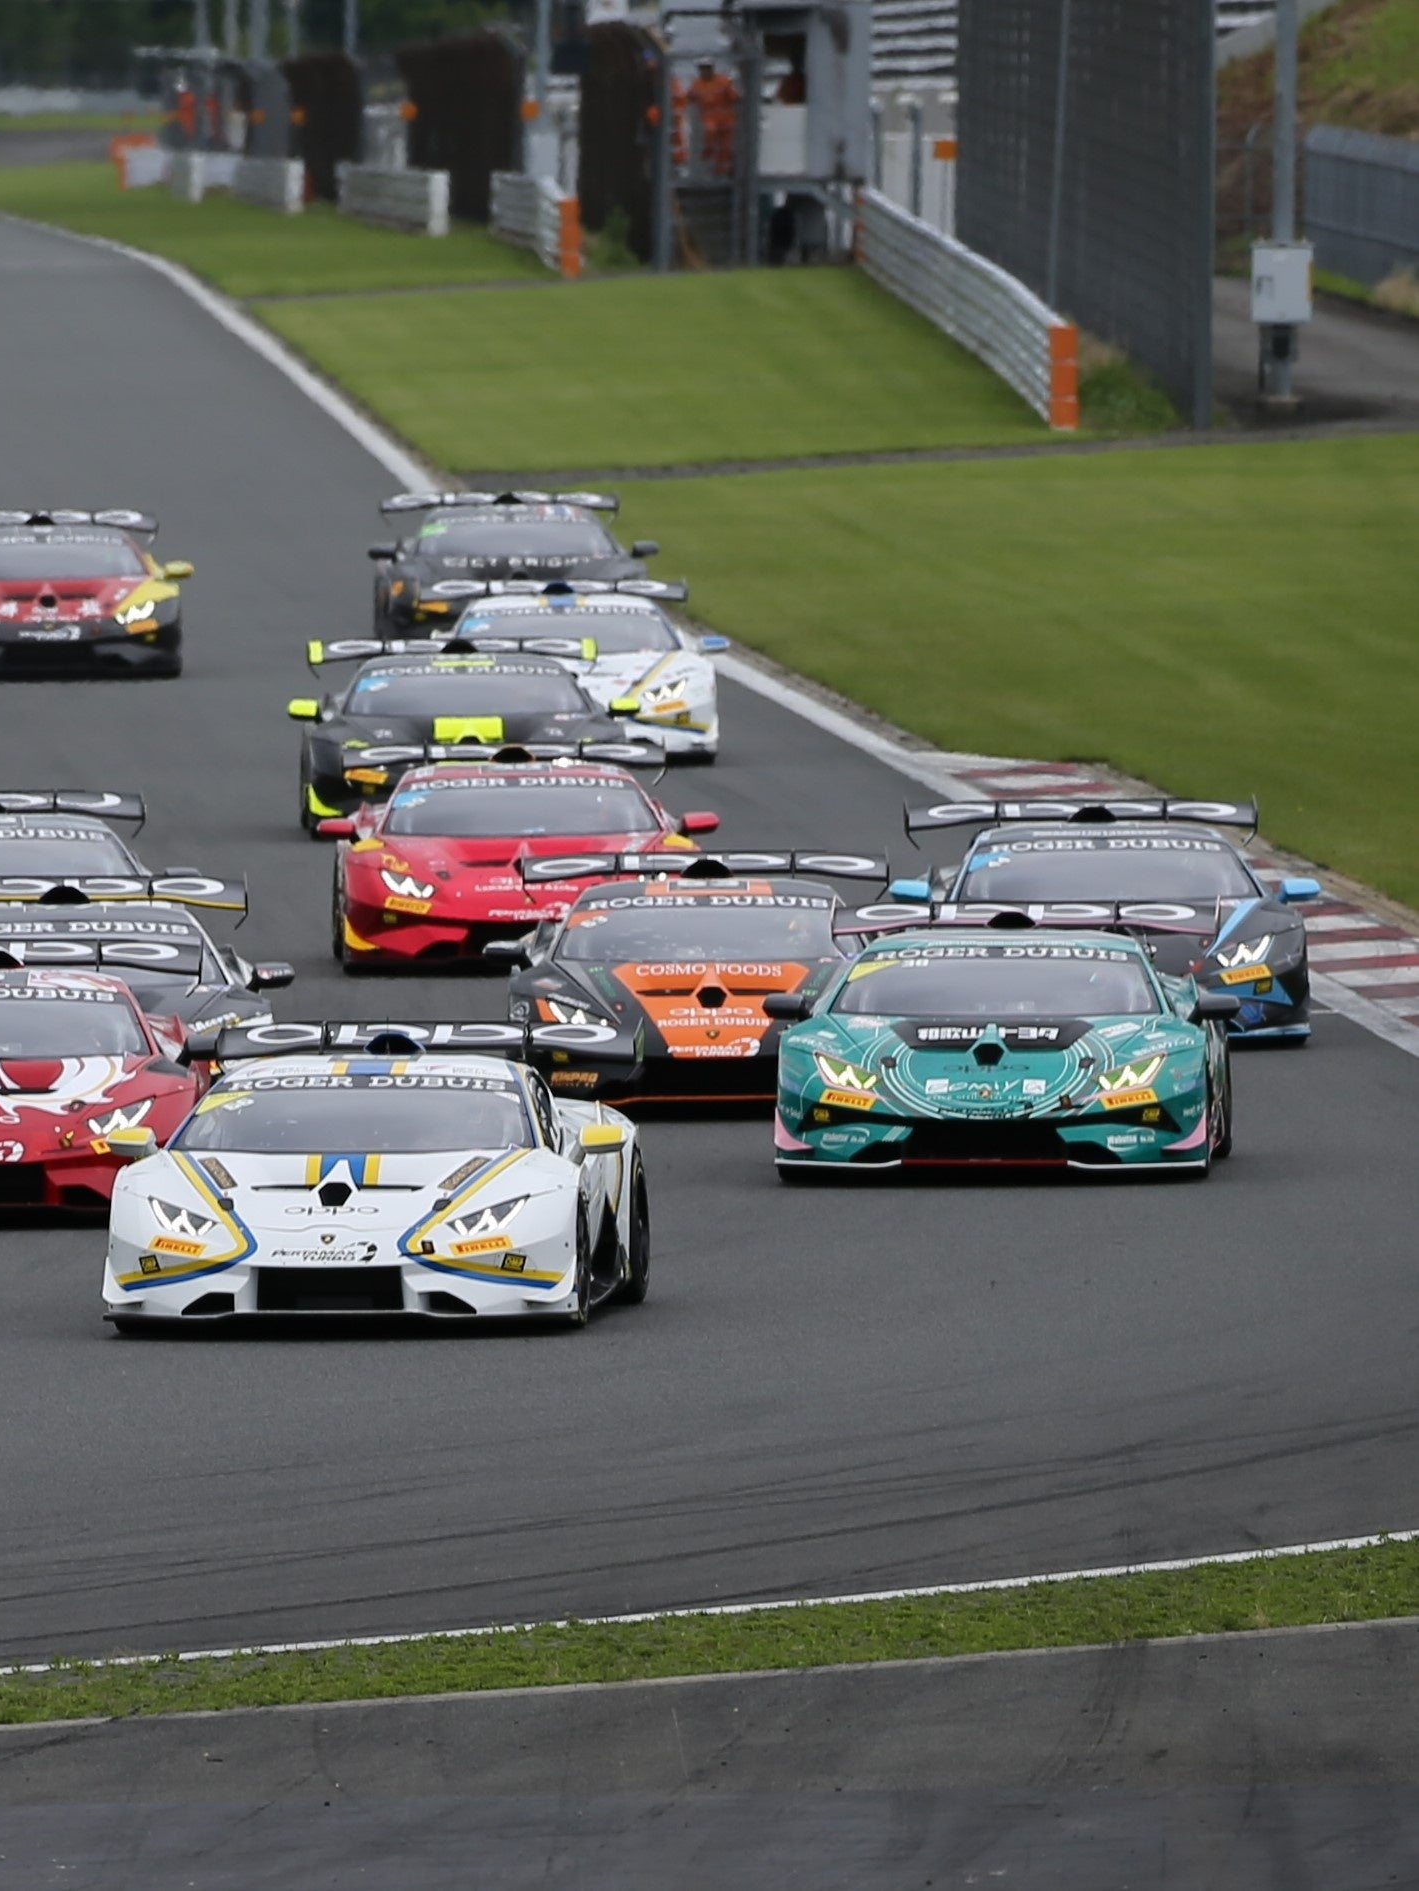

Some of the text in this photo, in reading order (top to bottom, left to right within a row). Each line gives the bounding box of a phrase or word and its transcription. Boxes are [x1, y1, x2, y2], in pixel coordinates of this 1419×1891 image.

[410, 777, 624, 791] ROGER DUBUIS
[990, 839, 1221, 853] ROGER DUBUIS
[588, 895, 828, 910] ROGER DUBUIS
[69, 921, 189, 935] DUBUIS
[876, 946, 1129, 961] ROGER DUBUIS
[636, 964, 782, 978] COSMO FOODS
[657, 1017, 770, 1027] ROGER DUBUIS
[229, 1075, 506, 1091] ROGER DUBUIS
[456, 1237, 507, 1254] PIRELLI
